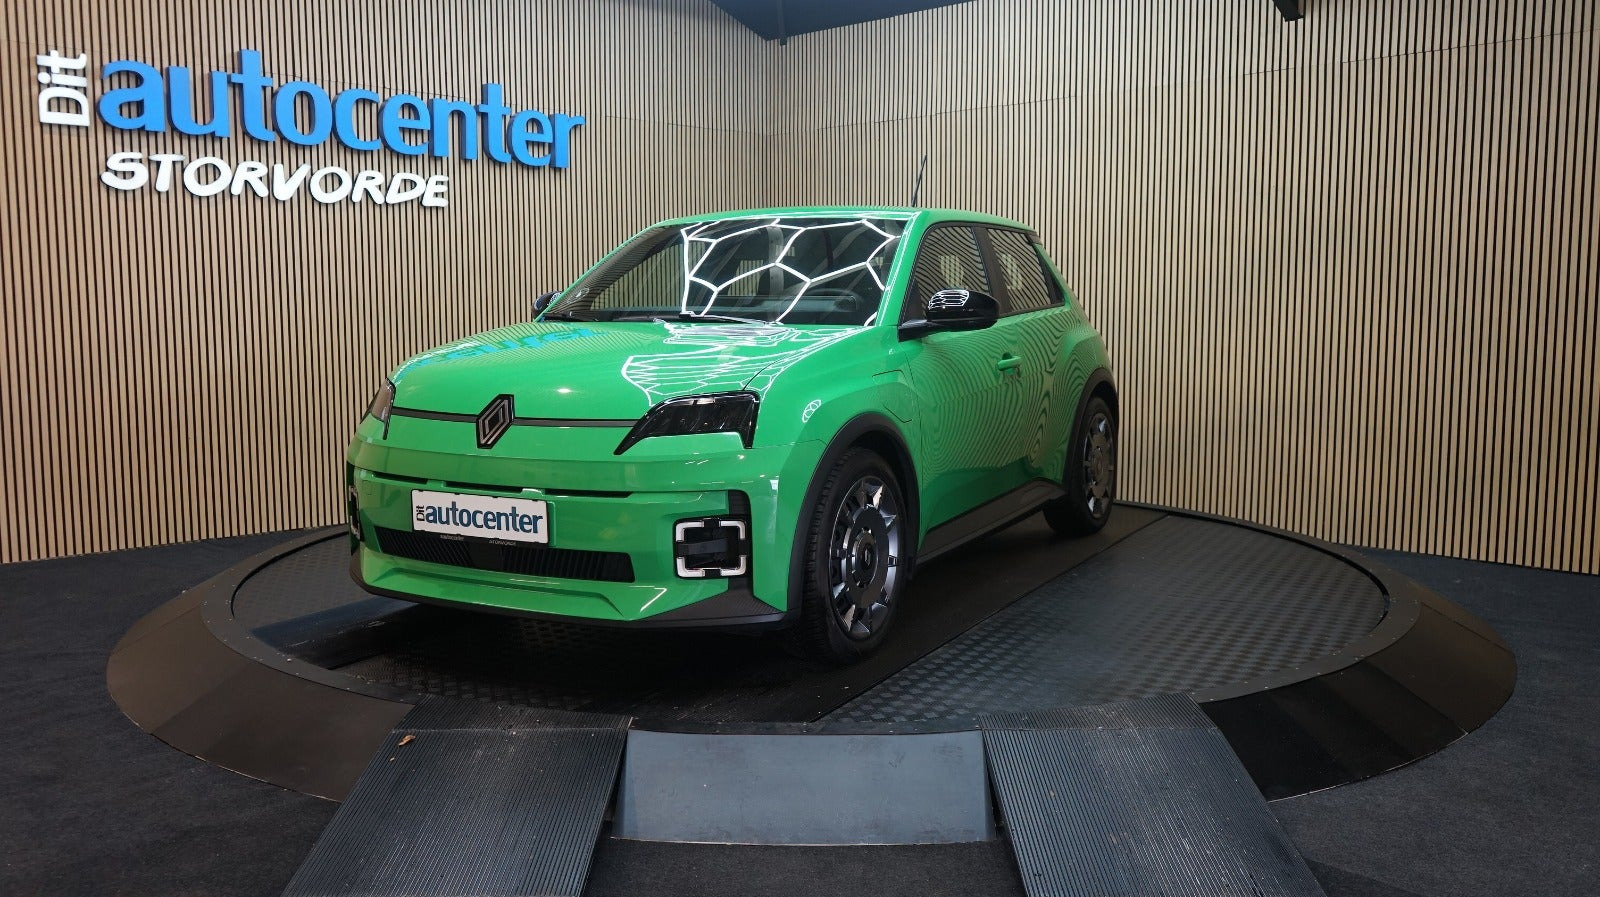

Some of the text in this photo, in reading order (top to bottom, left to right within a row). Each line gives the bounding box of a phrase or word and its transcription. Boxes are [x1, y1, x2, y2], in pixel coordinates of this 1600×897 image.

[37, 49, 586, 168] Dit autocenter
[101, 151, 449, 207] STORVORDE
[416, 501, 543, 533] Dit autocenter
